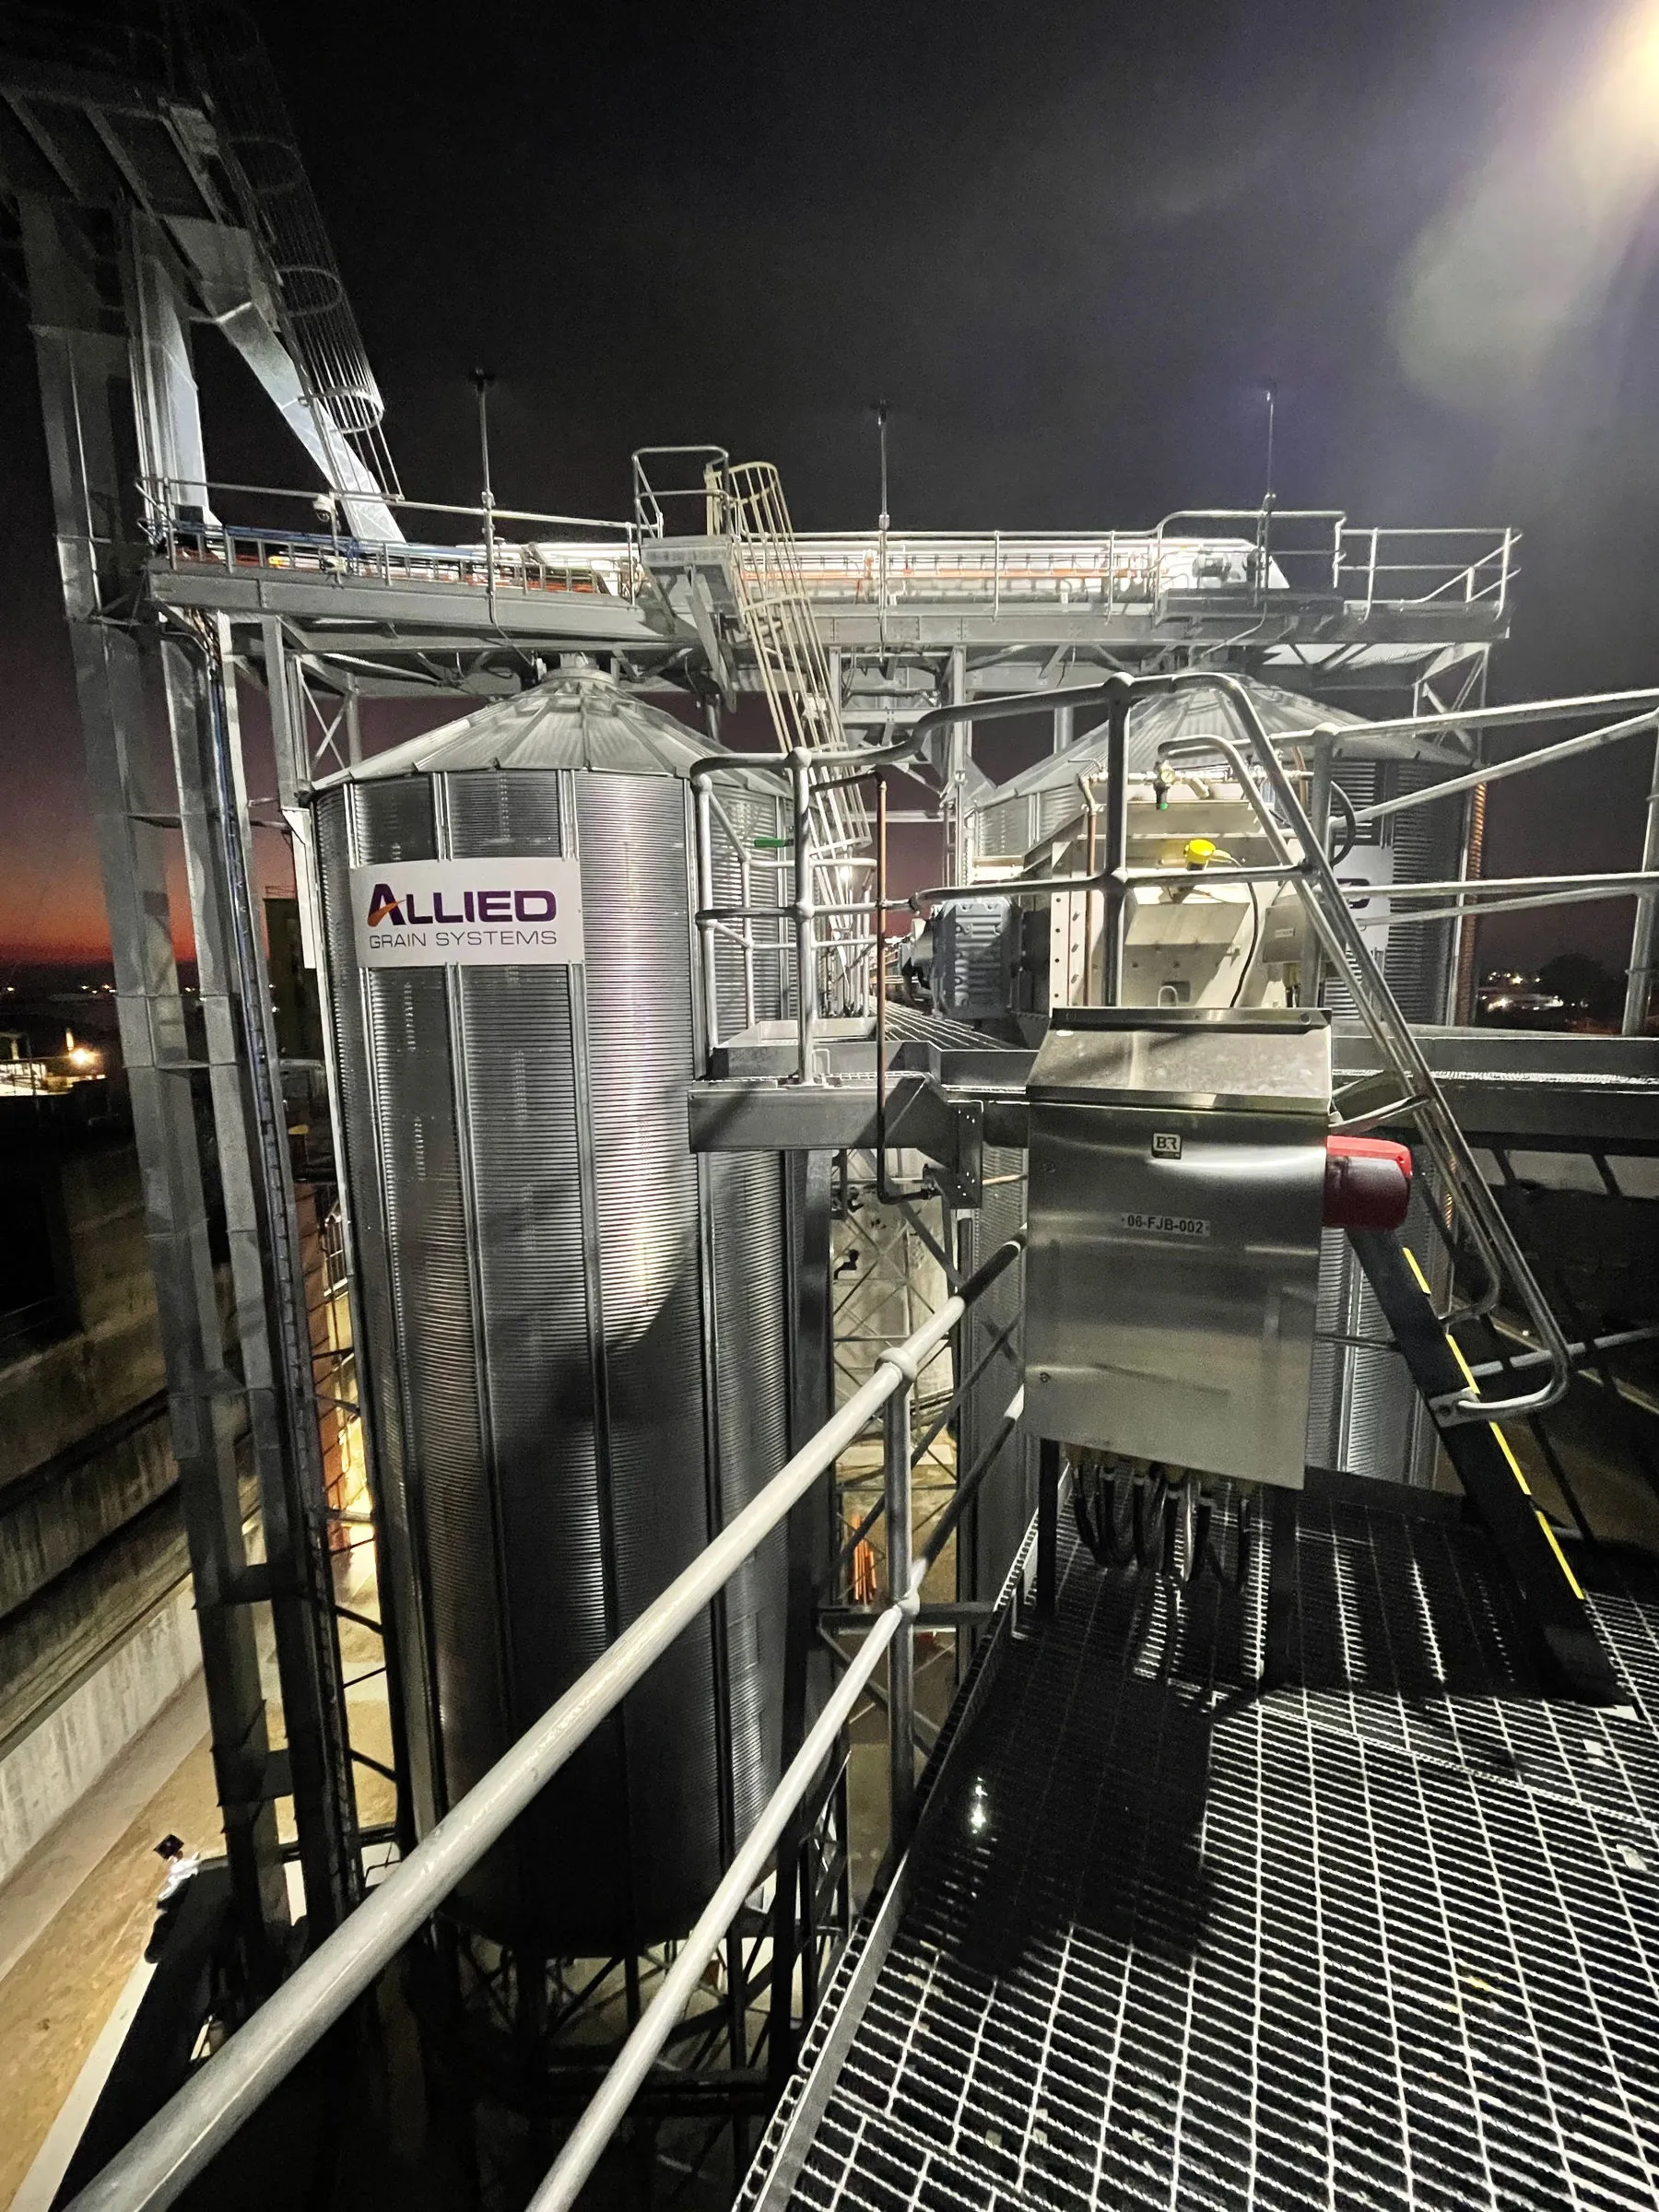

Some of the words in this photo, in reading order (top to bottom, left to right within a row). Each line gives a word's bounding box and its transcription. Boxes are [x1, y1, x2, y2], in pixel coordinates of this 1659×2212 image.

[367, 883, 557, 927] ALLIED
[370, 932, 426, 949] GRAIN
[436, 930, 557, 947] SYSTEMS
